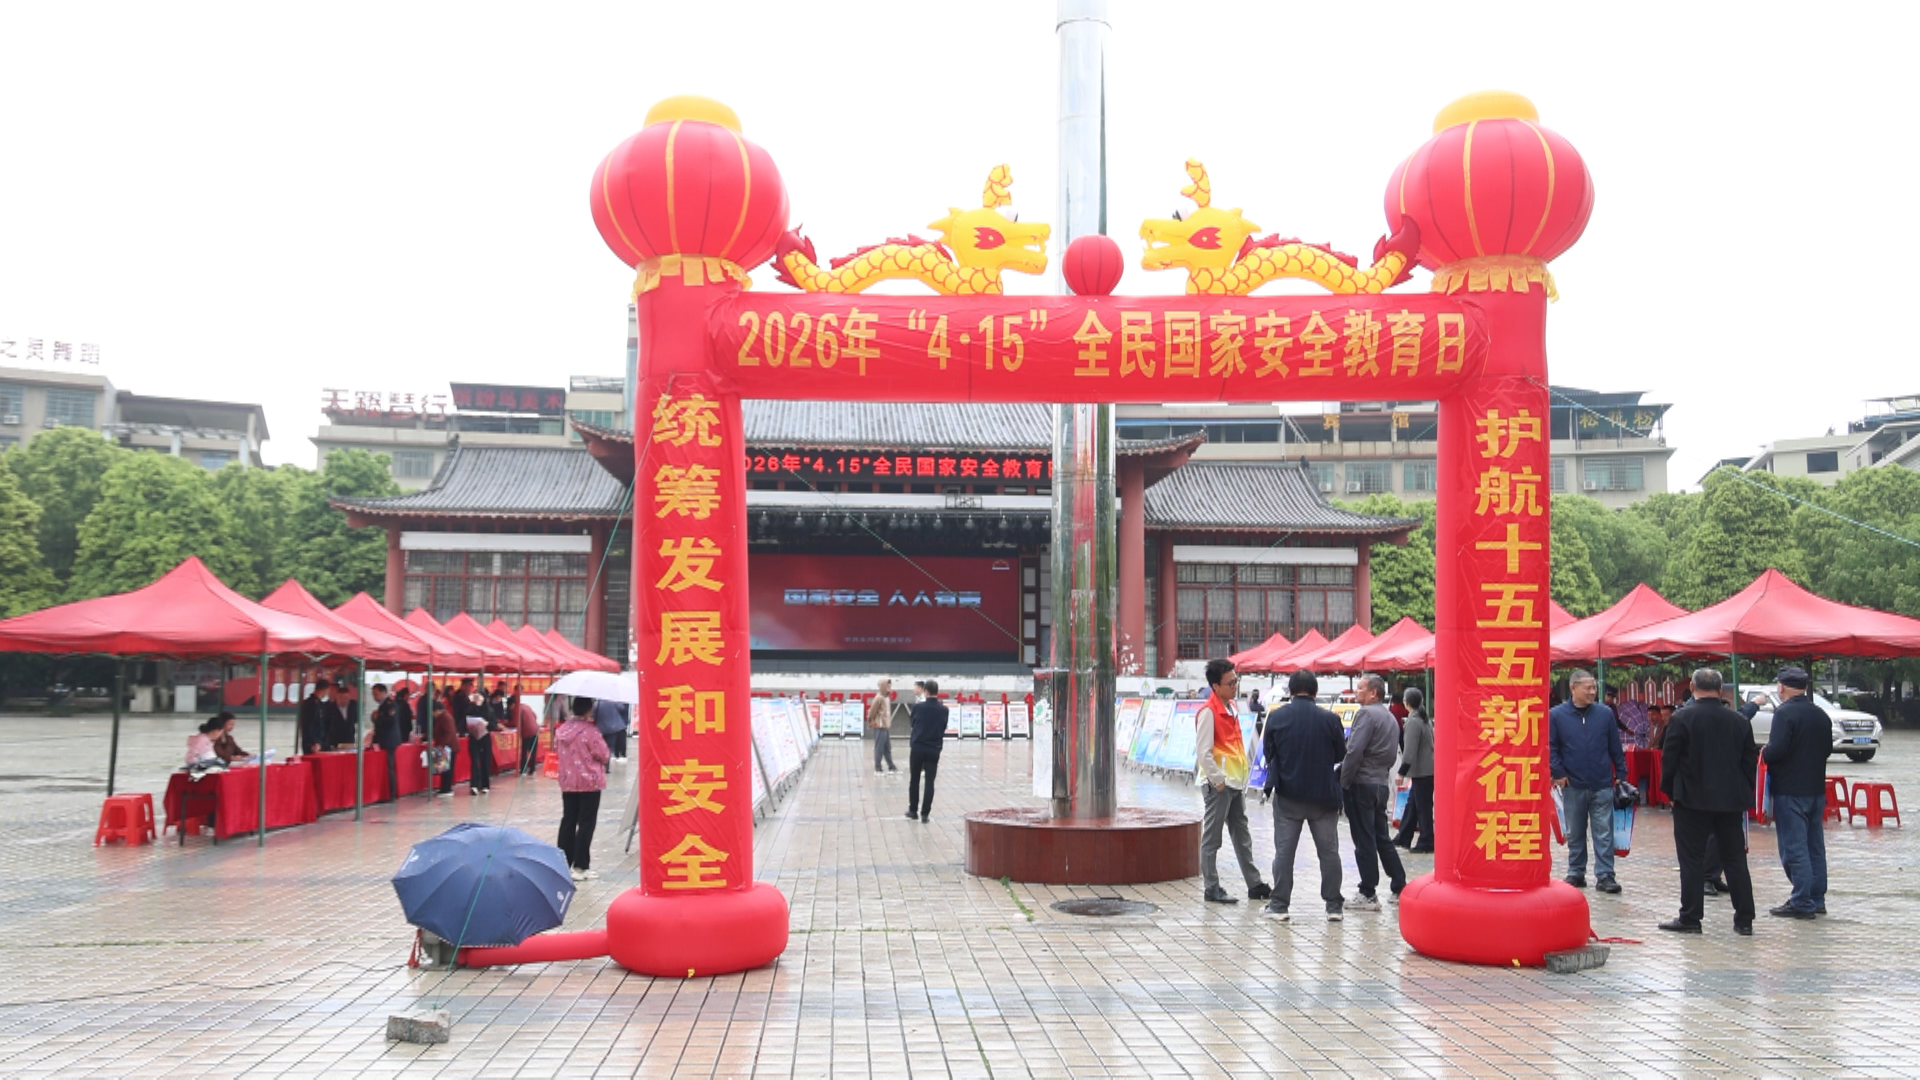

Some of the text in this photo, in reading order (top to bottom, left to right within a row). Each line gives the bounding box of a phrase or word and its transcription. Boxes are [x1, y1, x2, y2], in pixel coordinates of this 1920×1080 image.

[651, 392, 730, 890] 统筹发展和安全
[1474, 407, 1544, 861] 护航十五五新征程
